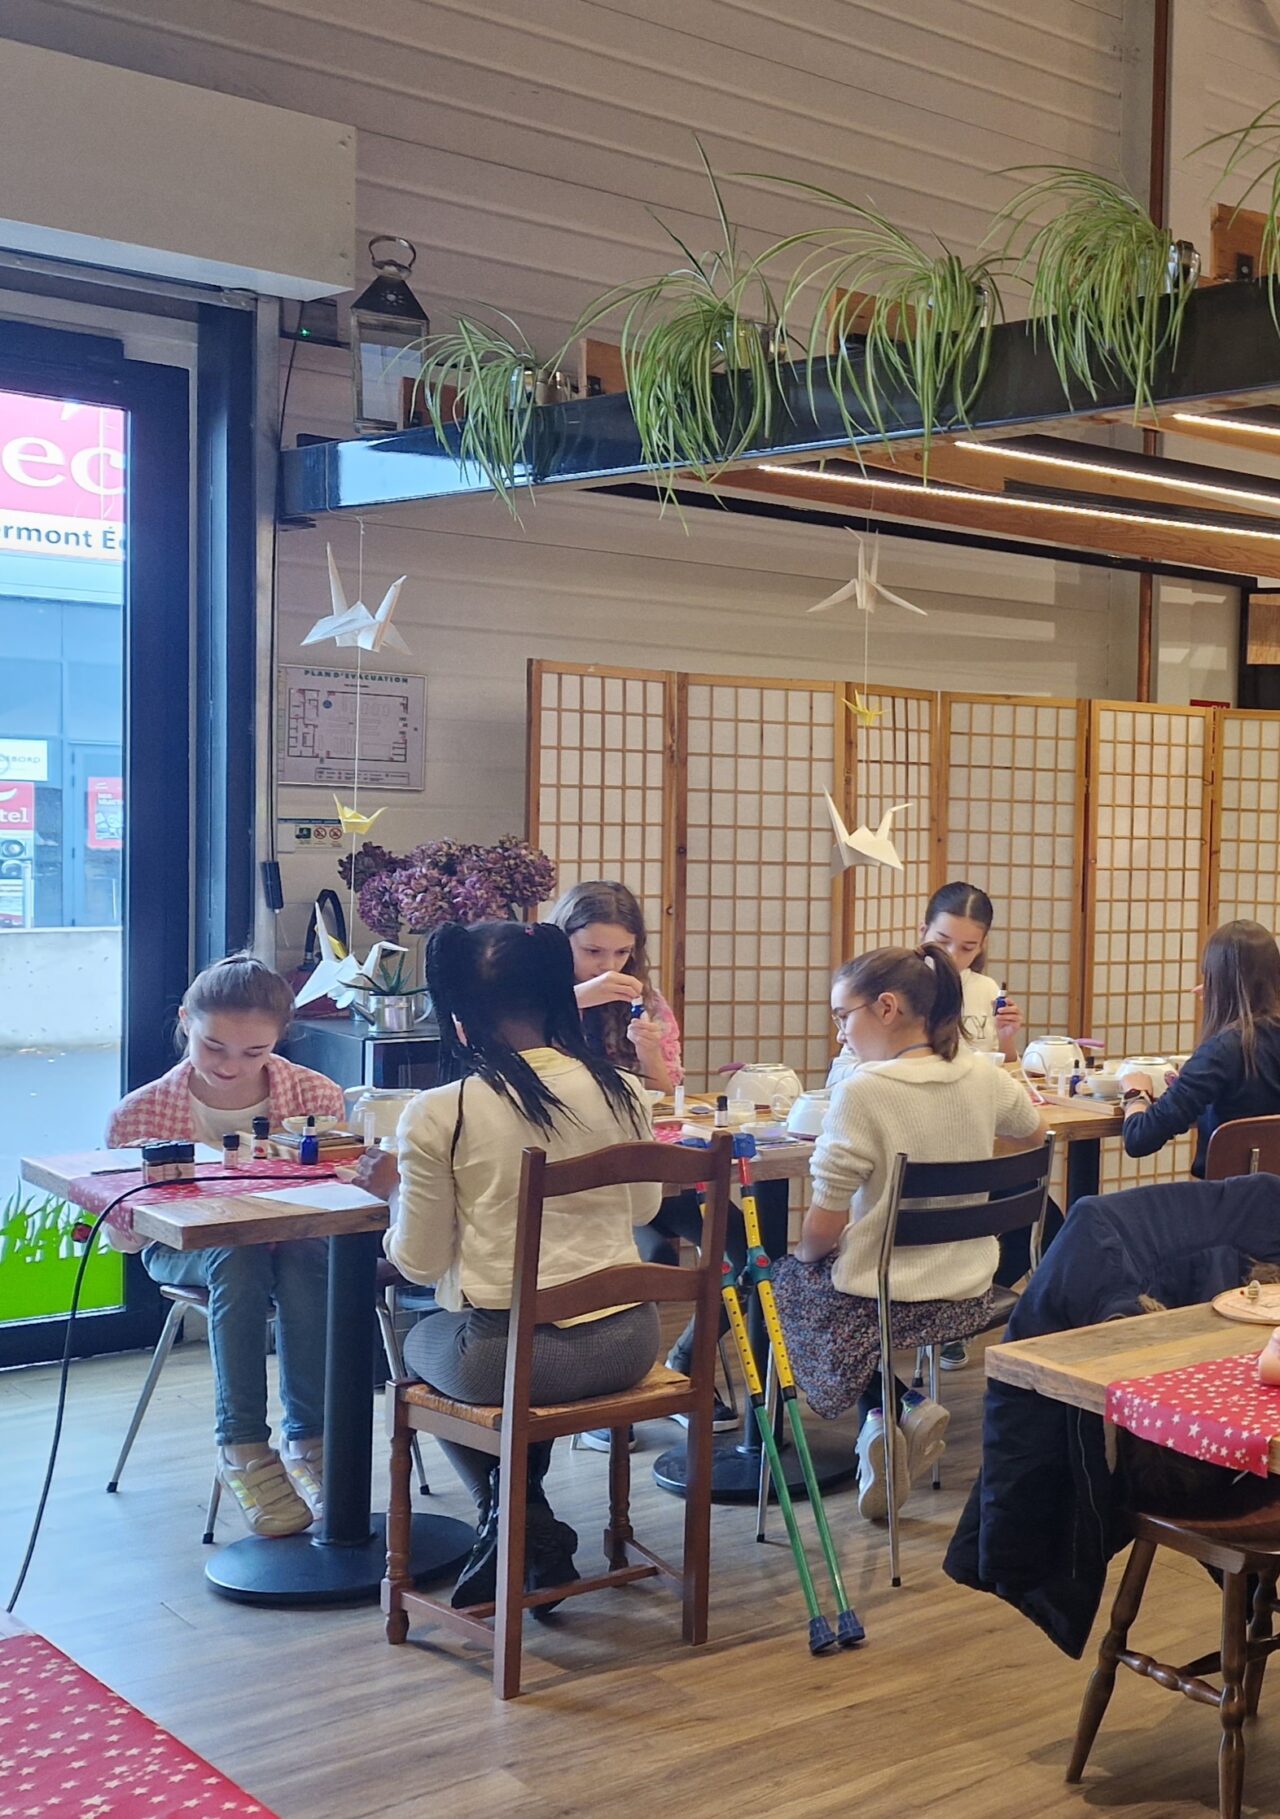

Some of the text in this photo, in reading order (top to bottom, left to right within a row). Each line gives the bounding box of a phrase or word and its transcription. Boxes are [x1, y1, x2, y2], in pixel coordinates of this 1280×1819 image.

[0, 525, 125, 550] rmont É
[304, 669, 331, 678] PLAN
